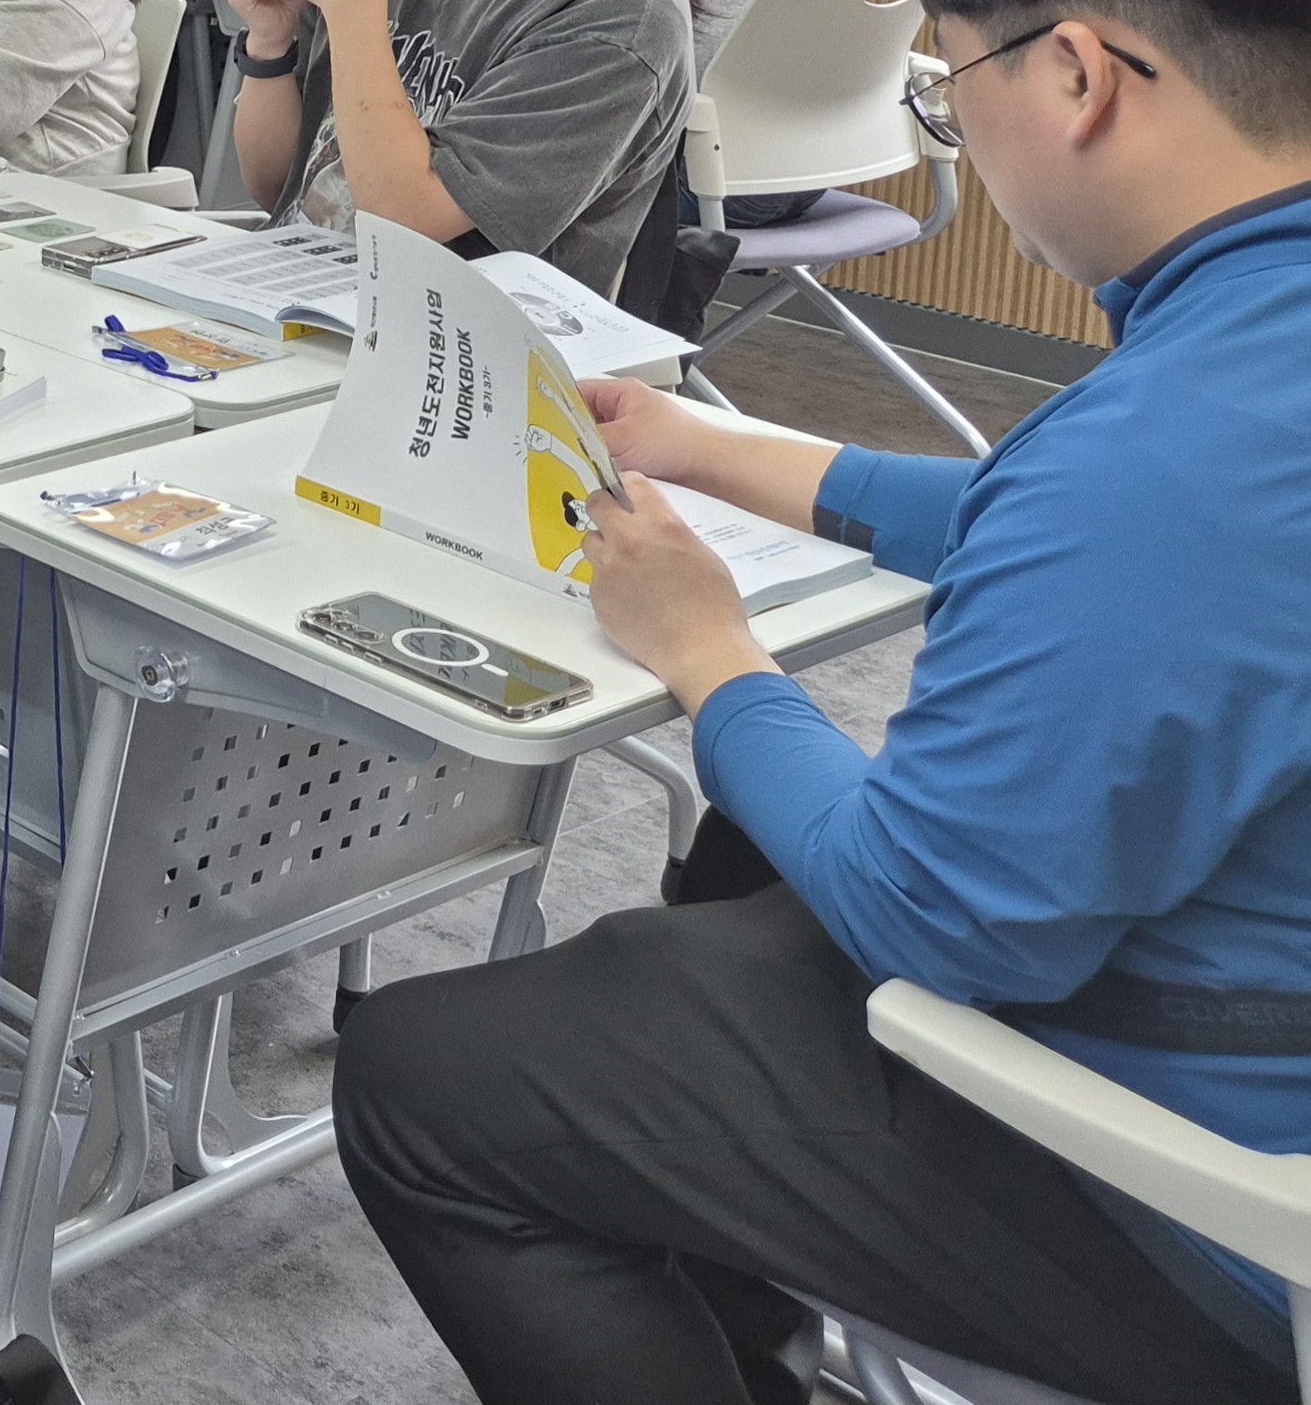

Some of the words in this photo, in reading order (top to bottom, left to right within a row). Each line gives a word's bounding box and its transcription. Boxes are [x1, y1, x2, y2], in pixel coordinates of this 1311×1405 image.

[408, 288, 446, 458] 청년도전지원사업
[451, 327, 475, 440] WORKBOOK
[320, 490, 339, 507] 중기
[344, 500, 360, 515] 3기
[425, 531, 484, 561] WORKBOOK
